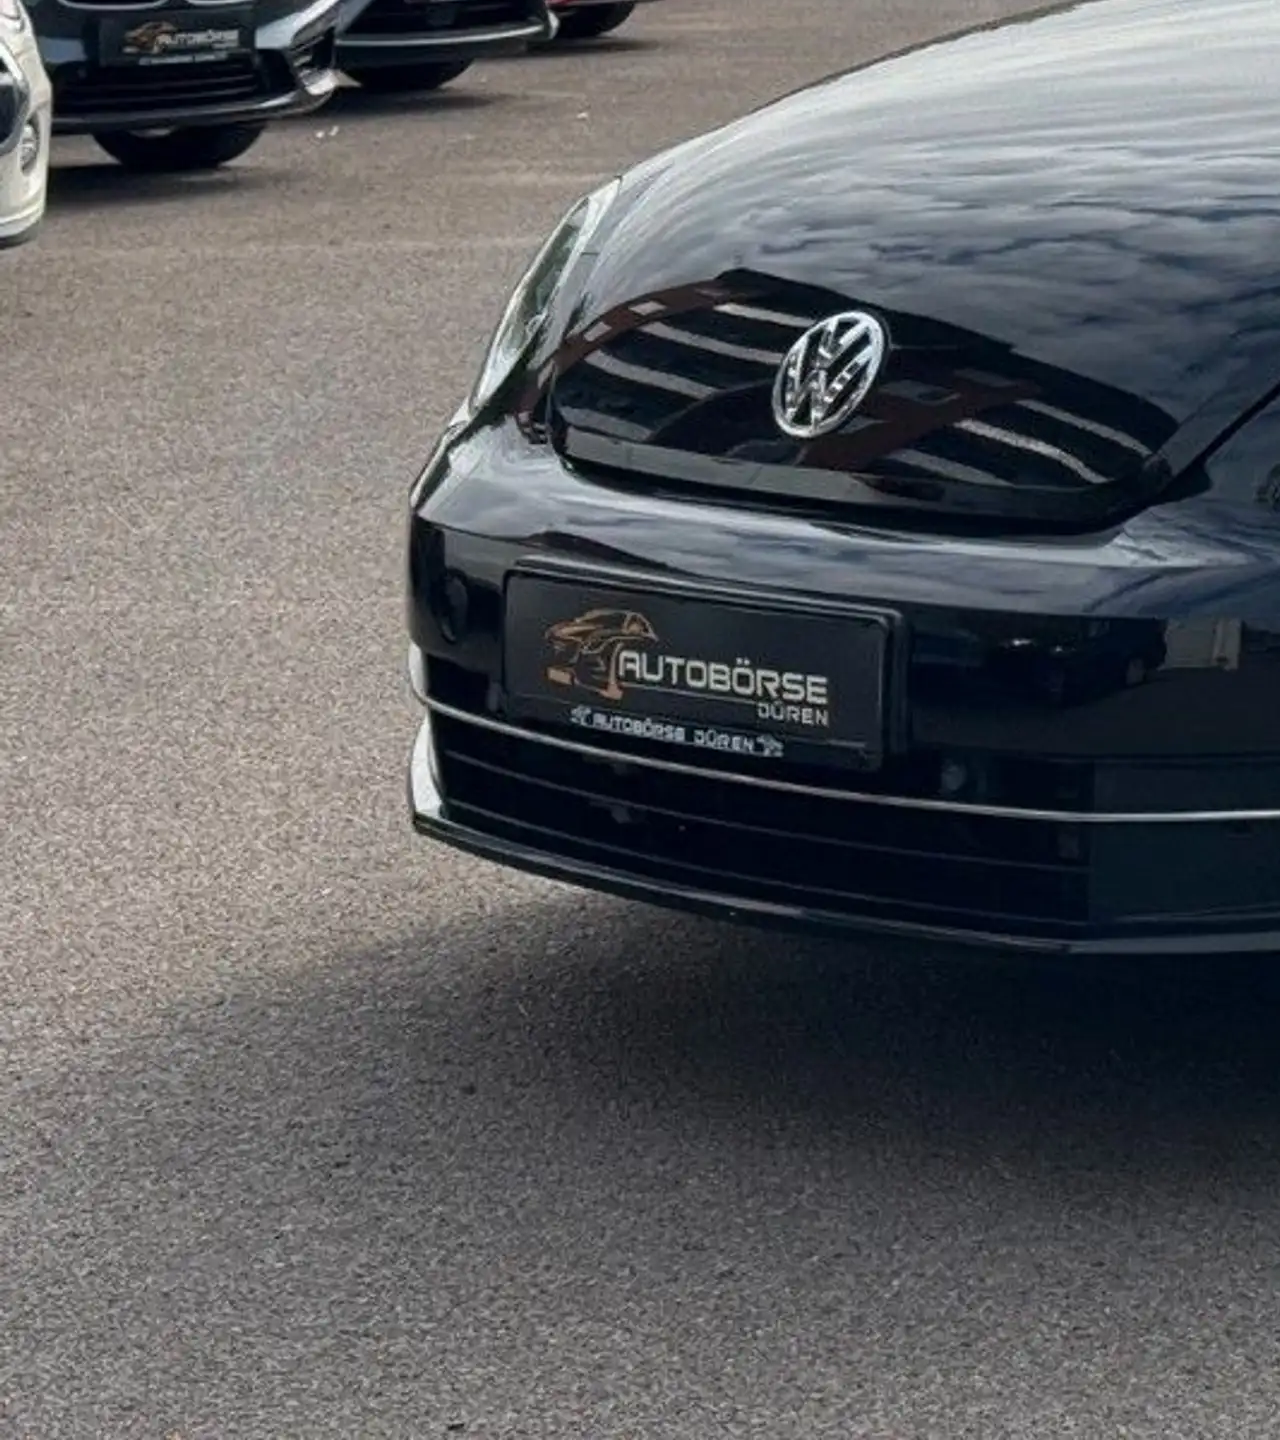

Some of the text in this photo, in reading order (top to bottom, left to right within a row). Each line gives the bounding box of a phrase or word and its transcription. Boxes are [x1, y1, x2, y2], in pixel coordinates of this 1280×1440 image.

[619, 651, 828, 704] AUTOBÖRSE
[594, 712, 755, 753] AUTOBÖRSE DÜREN
[758, 702, 829, 726] DÜREN
